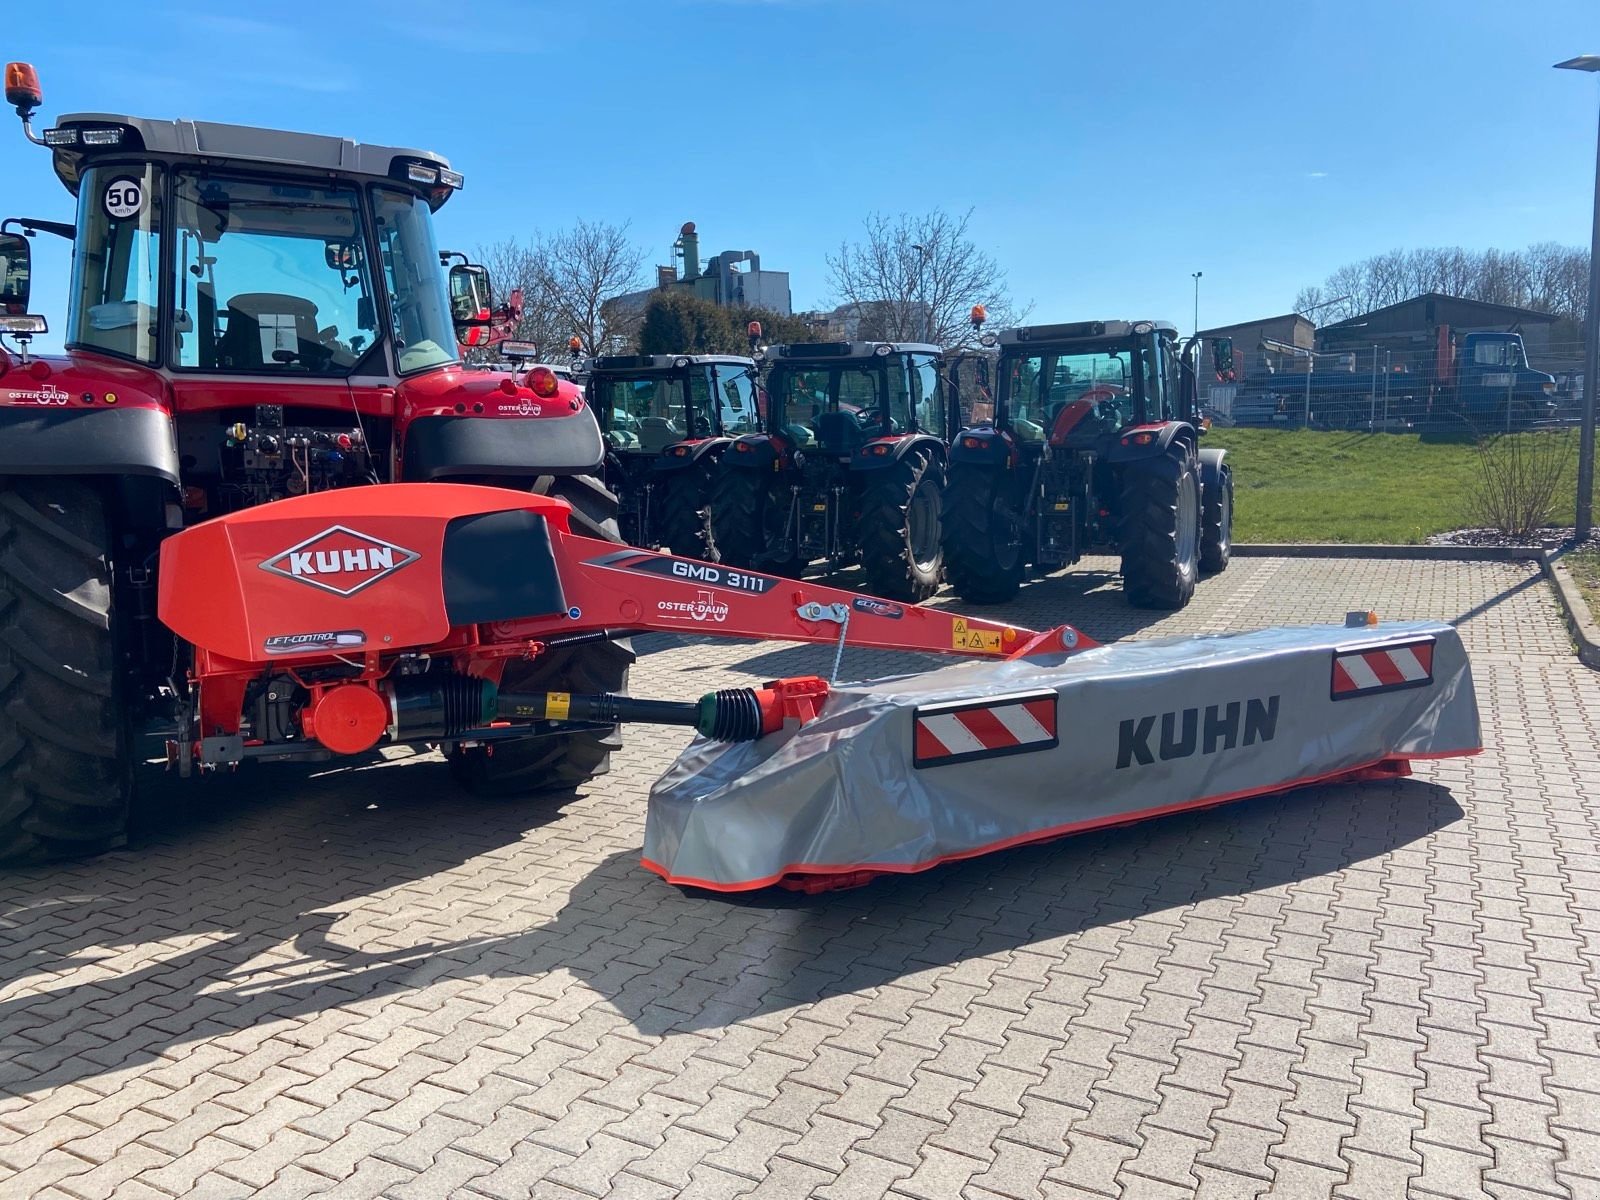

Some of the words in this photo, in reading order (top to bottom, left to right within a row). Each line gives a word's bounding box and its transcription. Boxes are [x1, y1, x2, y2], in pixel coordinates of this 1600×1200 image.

[108, 188, 140, 207] 50
[8, 391, 69, 401] OSTER-DAUM
[498, 404, 541, 412] OSTER-DAUM
[290, 547, 394, 576] KUHN
[672, 561, 720, 584] GMD
[727, 571, 764, 593] 3111
[657, 600, 729, 616] OSTER-DAUM
[266, 632, 337, 645] LIFT-CONTROL
[1115, 695, 1280, 770] KUHN
